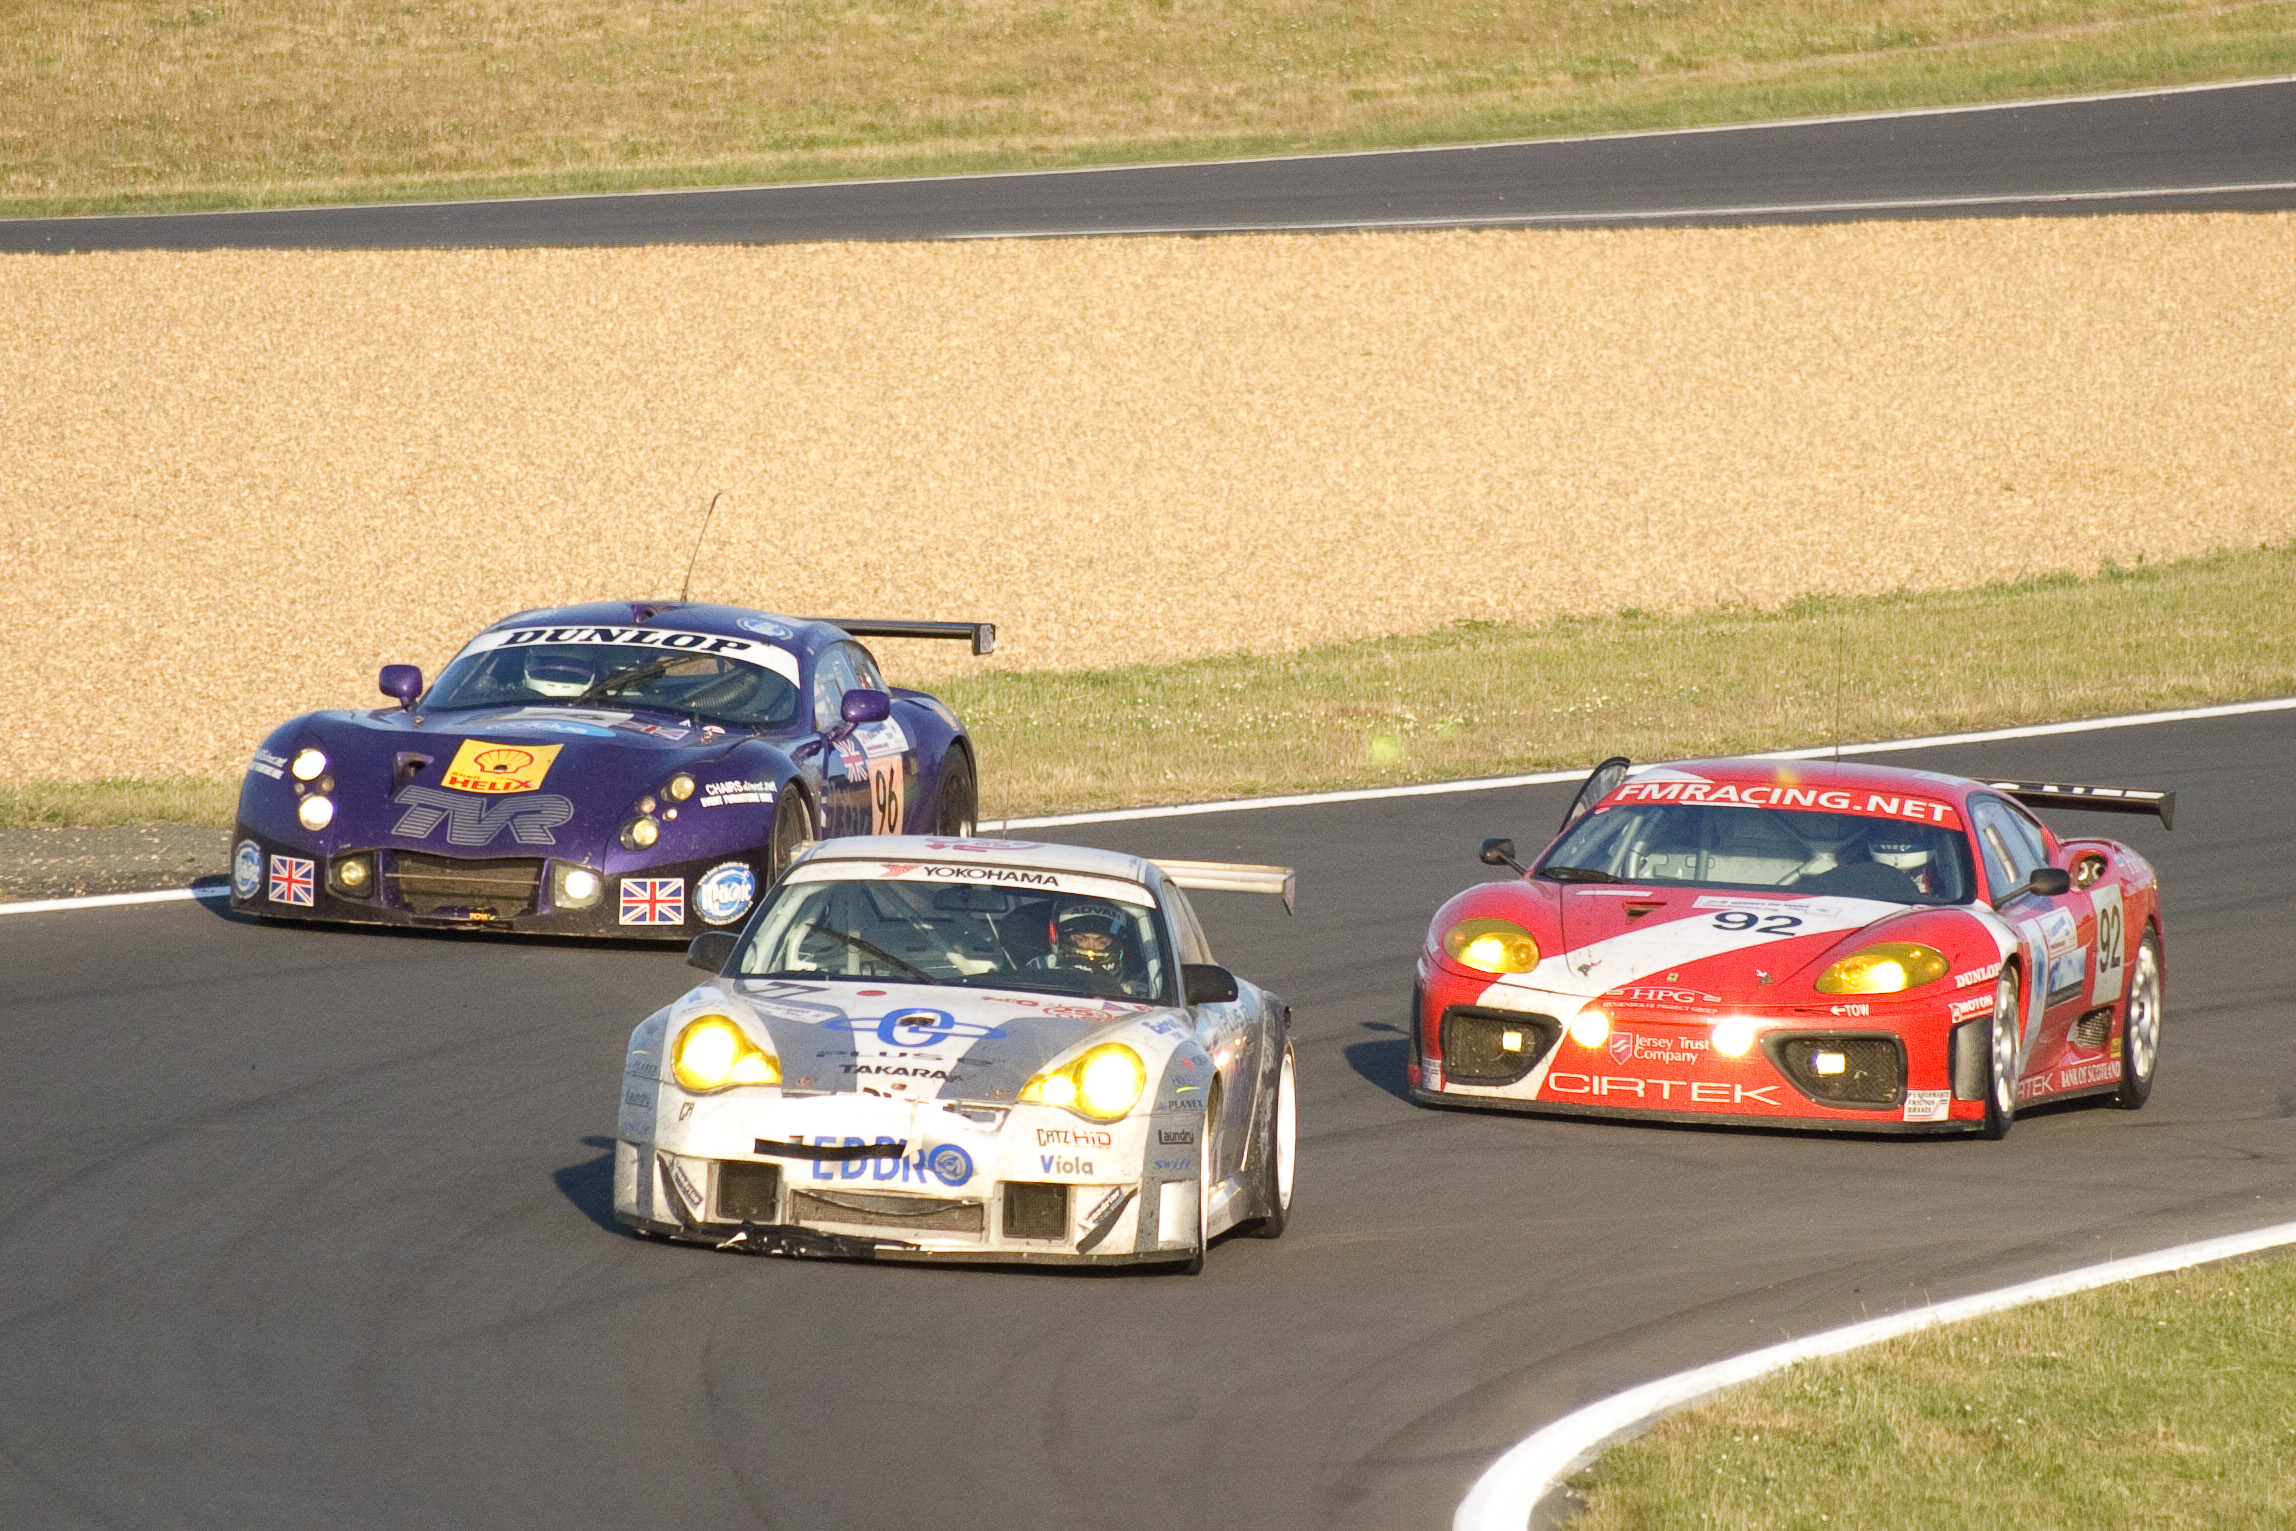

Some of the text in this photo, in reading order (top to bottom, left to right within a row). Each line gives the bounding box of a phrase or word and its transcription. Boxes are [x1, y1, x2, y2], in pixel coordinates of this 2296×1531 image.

[499, 628, 752, 652] DUNLOP
[448, 776, 533, 791] HELIX
[875, 764, 899, 835] 96
[1614, 783, 1952, 823] FMRACING.NET
[391, 785, 575, 846] TVR
[924, 866, 1059, 887] YOKOHAMA
[1712, 911, 1803, 937] 92
[2099, 904, 2121, 974] 92
[1953, 962, 2001, 988] DUNLOP
[1630, 988, 1696, 1004] HPG
[1845, 1003, 1870, 1017] TOW
[1635, 1033, 1710, 1051] Jersey Trust
[1634, 1046, 1699, 1065] Company
[839, 1064, 964, 1083] TAKARA
[1548, 1072, 1782, 1106] CIRTEK
[1036, 1128, 1070, 1146] CATZ
[1158, 1129, 1195, 1145] Laundry
[1040, 1154, 1094, 1176] Viola
